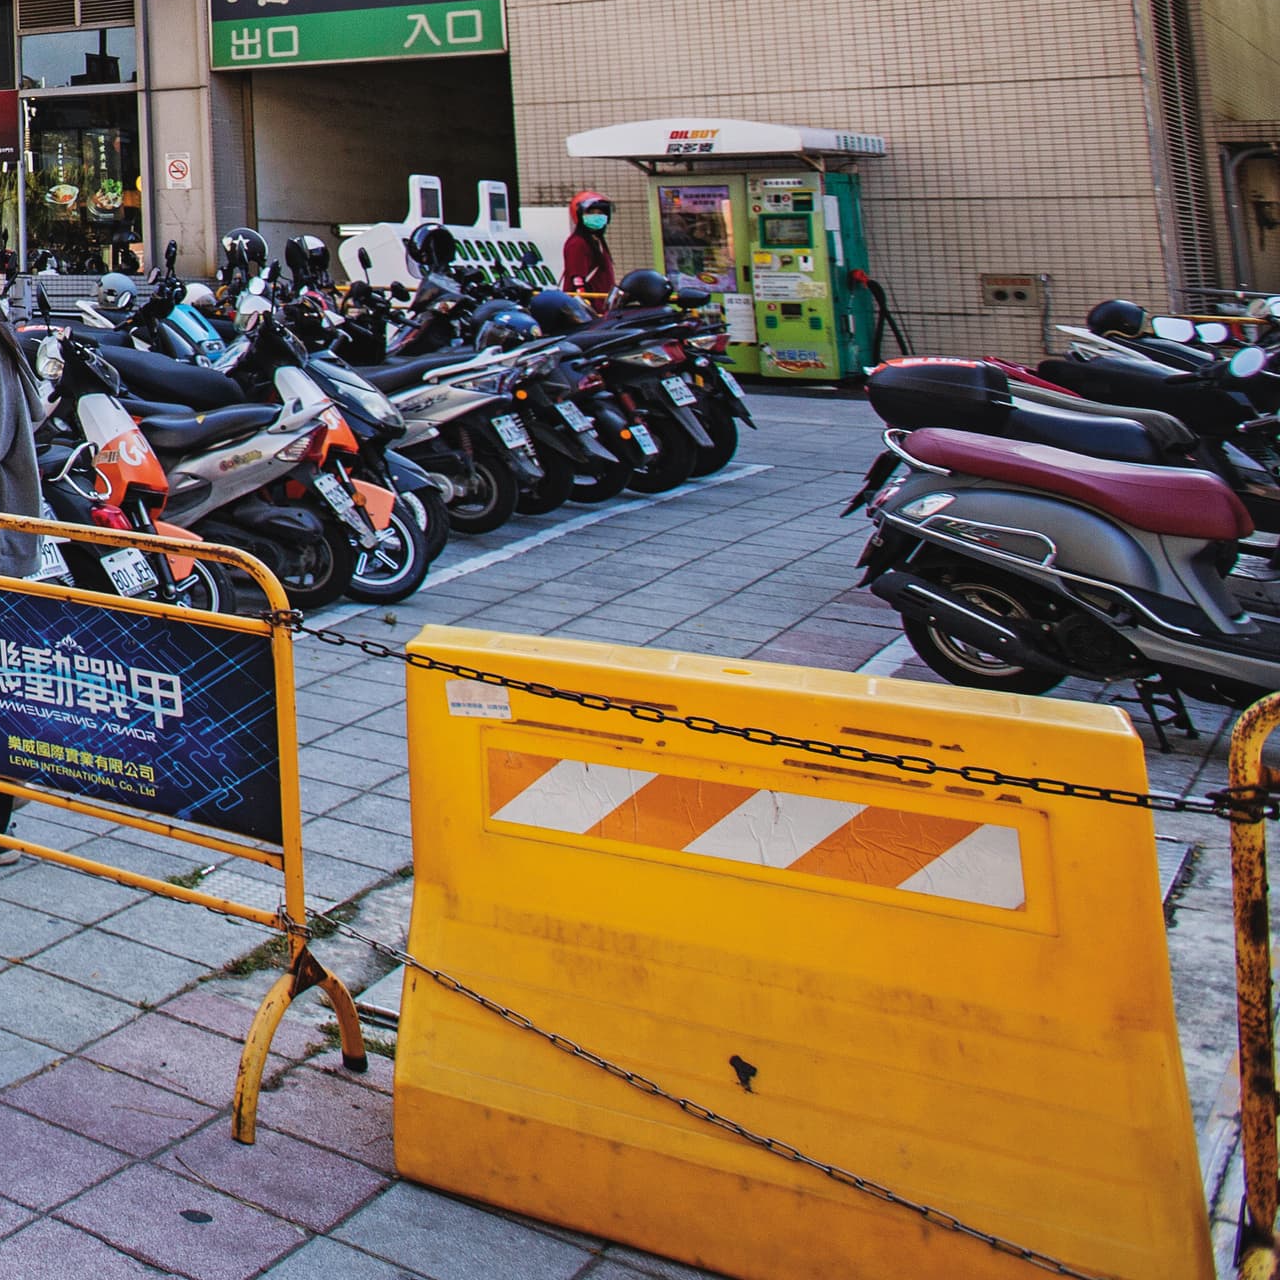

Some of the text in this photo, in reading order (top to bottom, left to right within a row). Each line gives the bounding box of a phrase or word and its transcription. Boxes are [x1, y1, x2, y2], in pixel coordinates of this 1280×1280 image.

[230, 9, 483, 59] 出口 入口
[101, 722, 157, 743] ARMOR
[7, 735, 155, 782] 樂威國際實業有限公司
[9, 754, 39, 769] LEWEI
[41, 762, 116, 788] INTERNATIONAL
